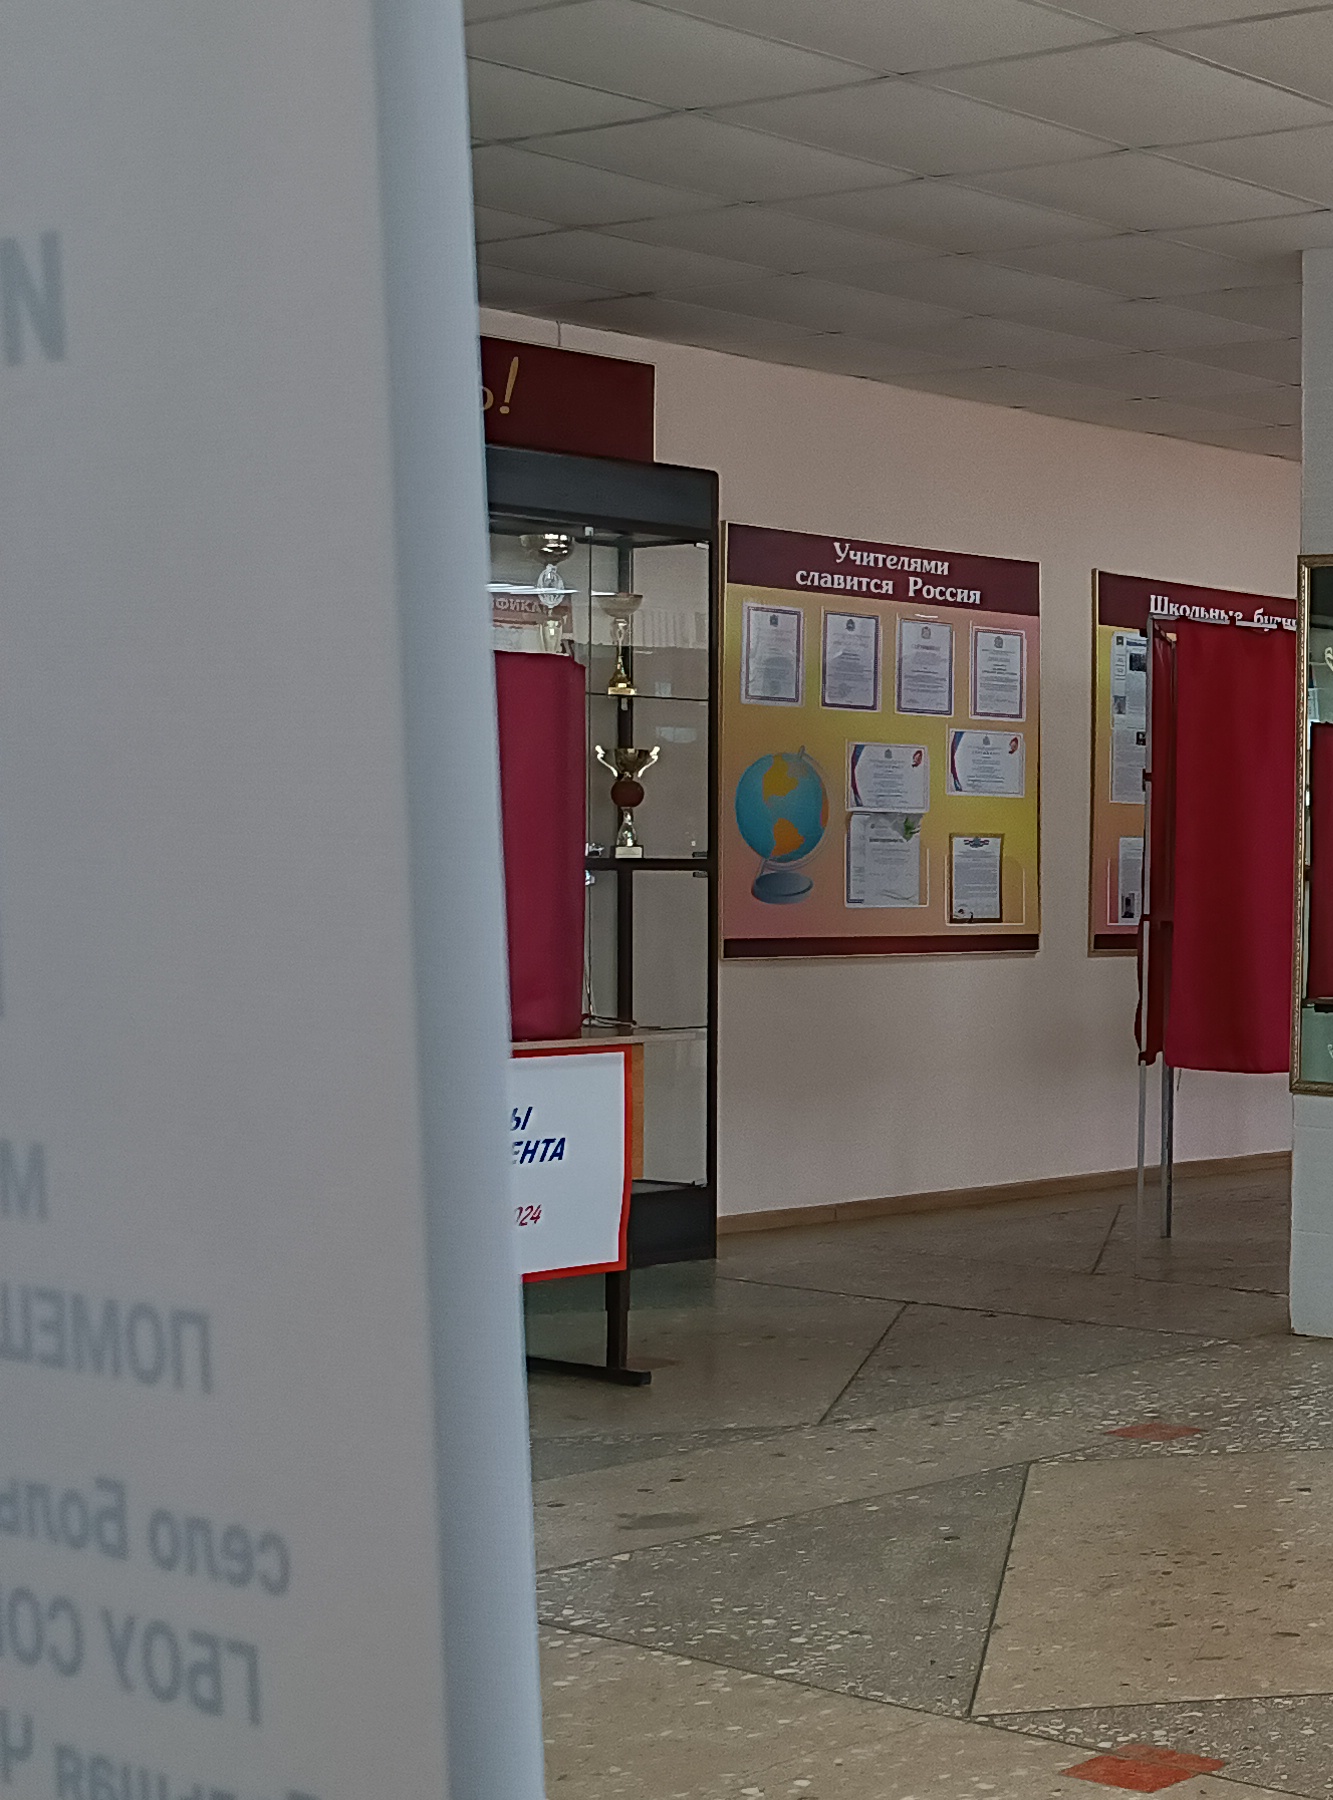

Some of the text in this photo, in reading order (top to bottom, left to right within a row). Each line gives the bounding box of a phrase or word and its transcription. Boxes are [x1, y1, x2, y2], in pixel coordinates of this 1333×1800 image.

[833, 541, 949, 576] Учителями
[795, 570, 981, 605] славится Россия
